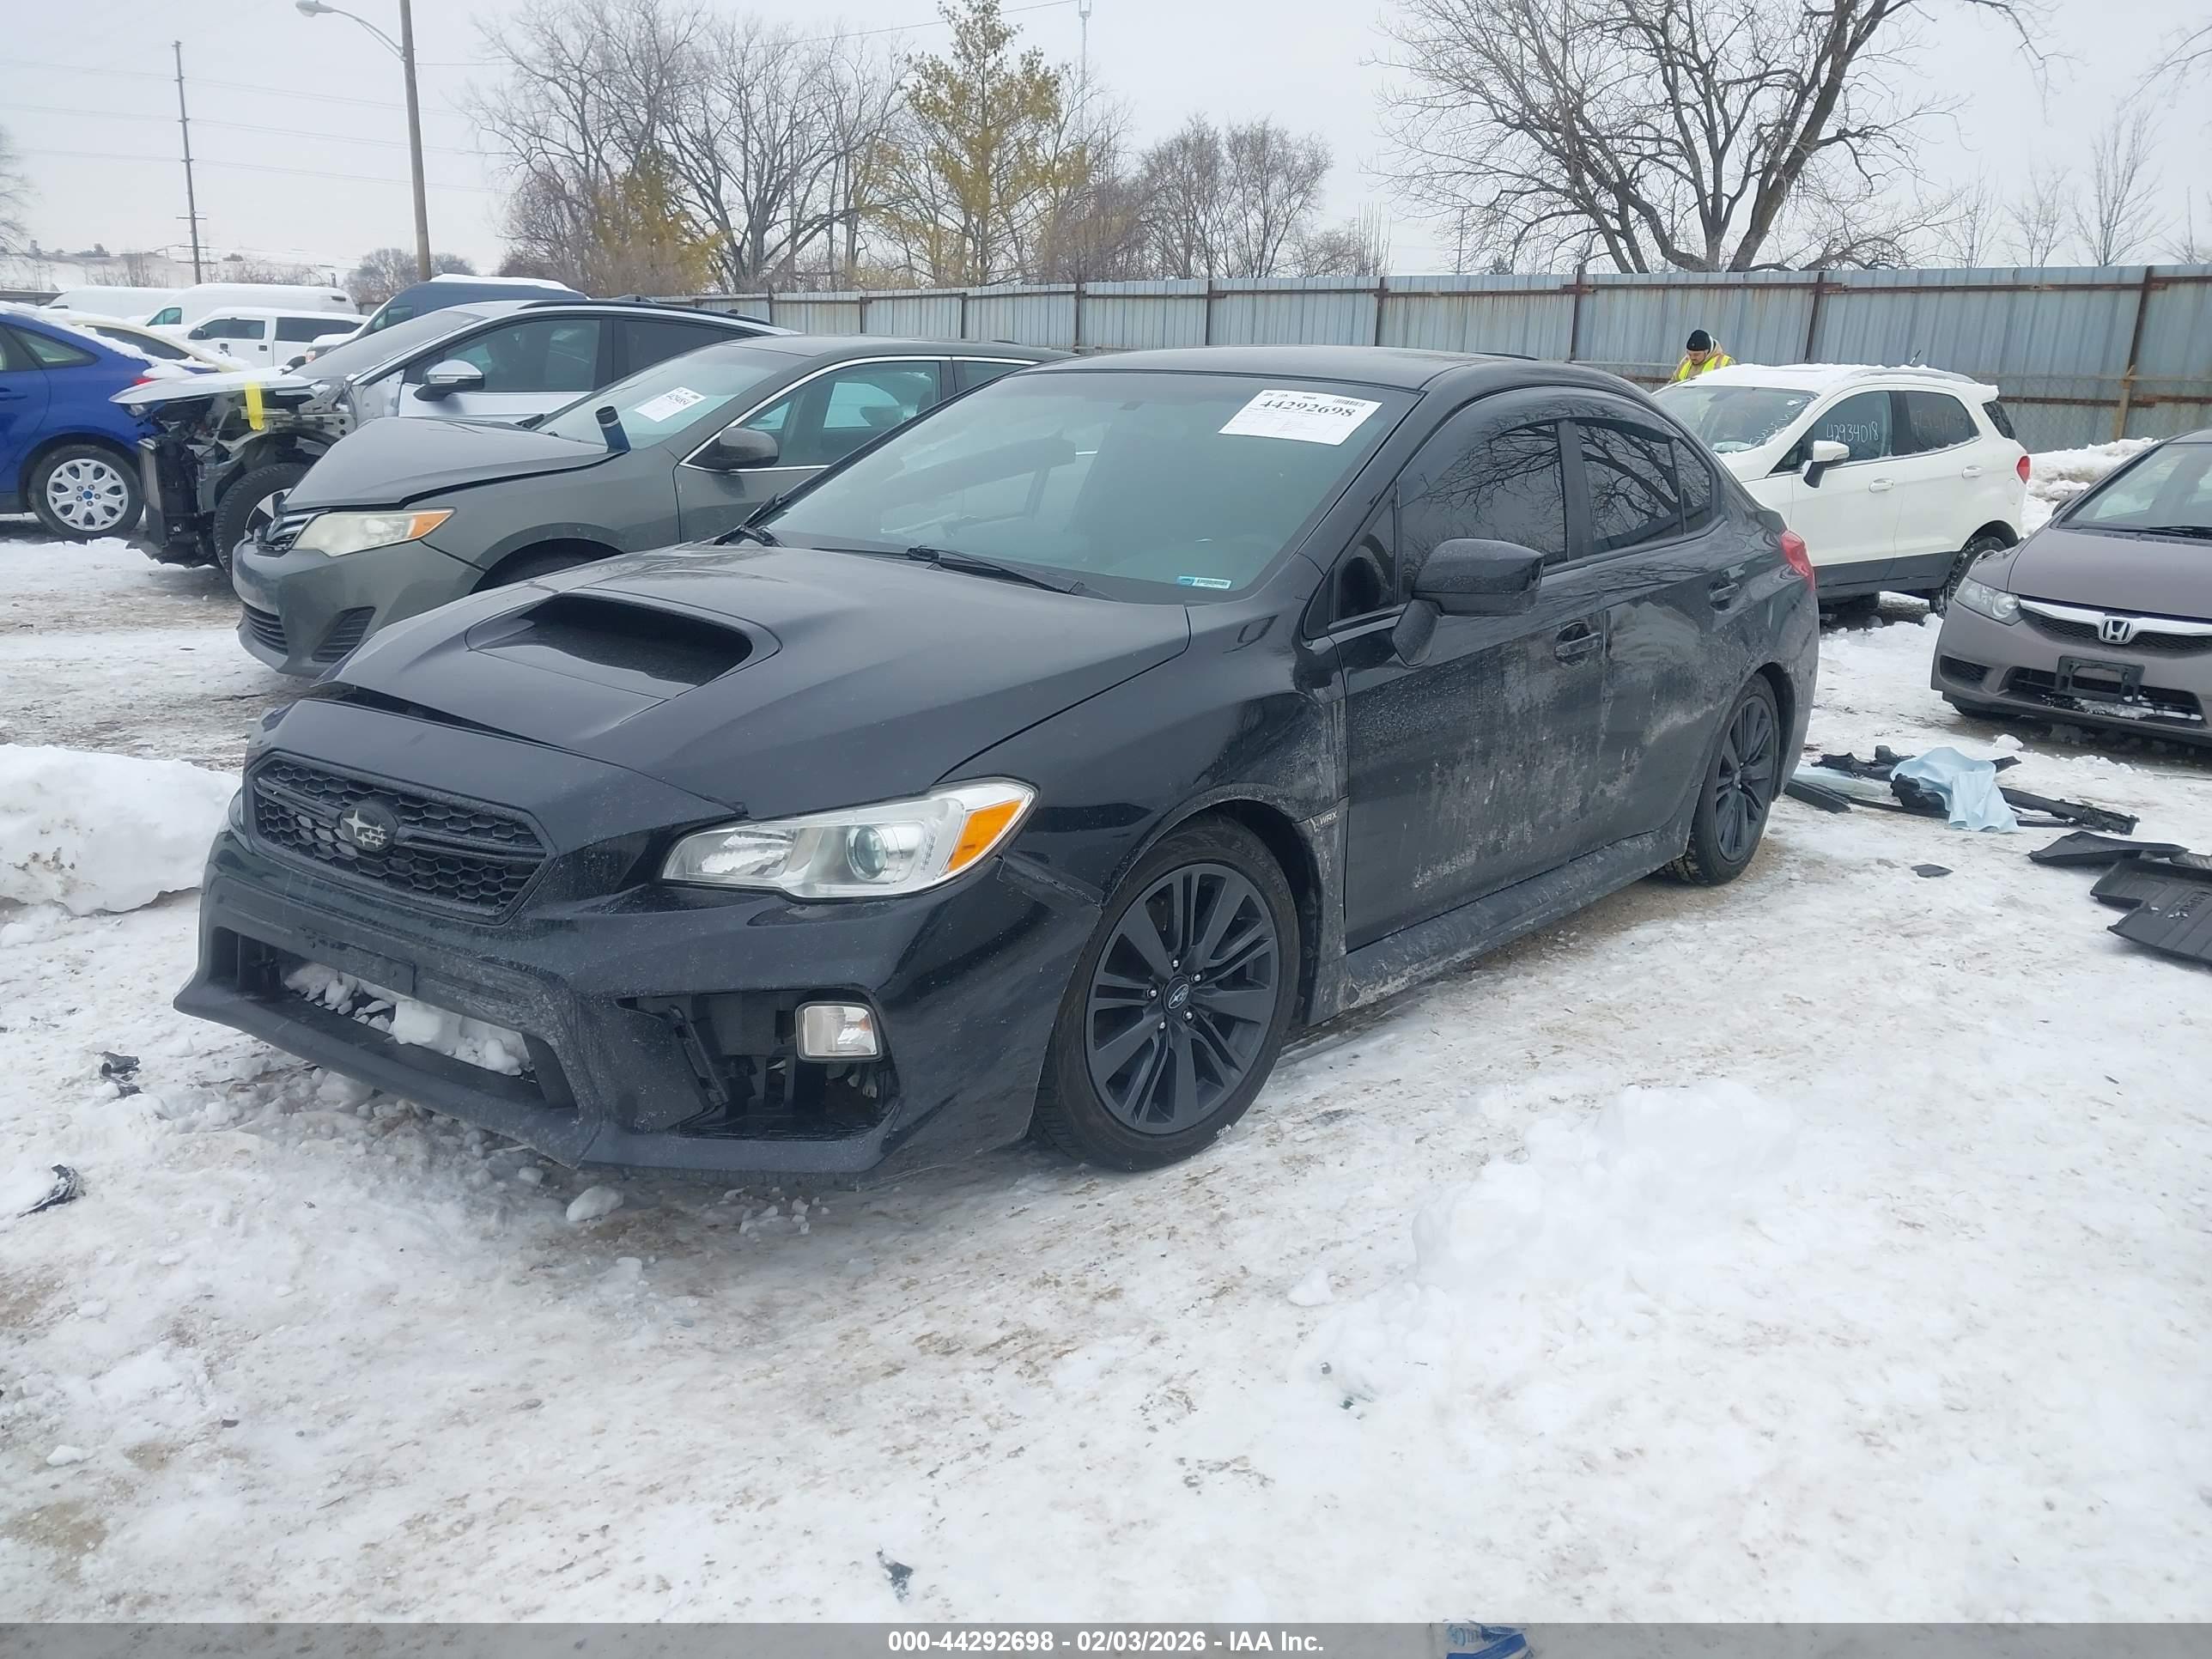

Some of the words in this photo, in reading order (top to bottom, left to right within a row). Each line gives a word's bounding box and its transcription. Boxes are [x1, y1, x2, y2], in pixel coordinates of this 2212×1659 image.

[1259, 399, 1356, 417] 44292698
[1826, 421, 1879, 443] 42934018
[1319, 810, 1338, 825] WRX
